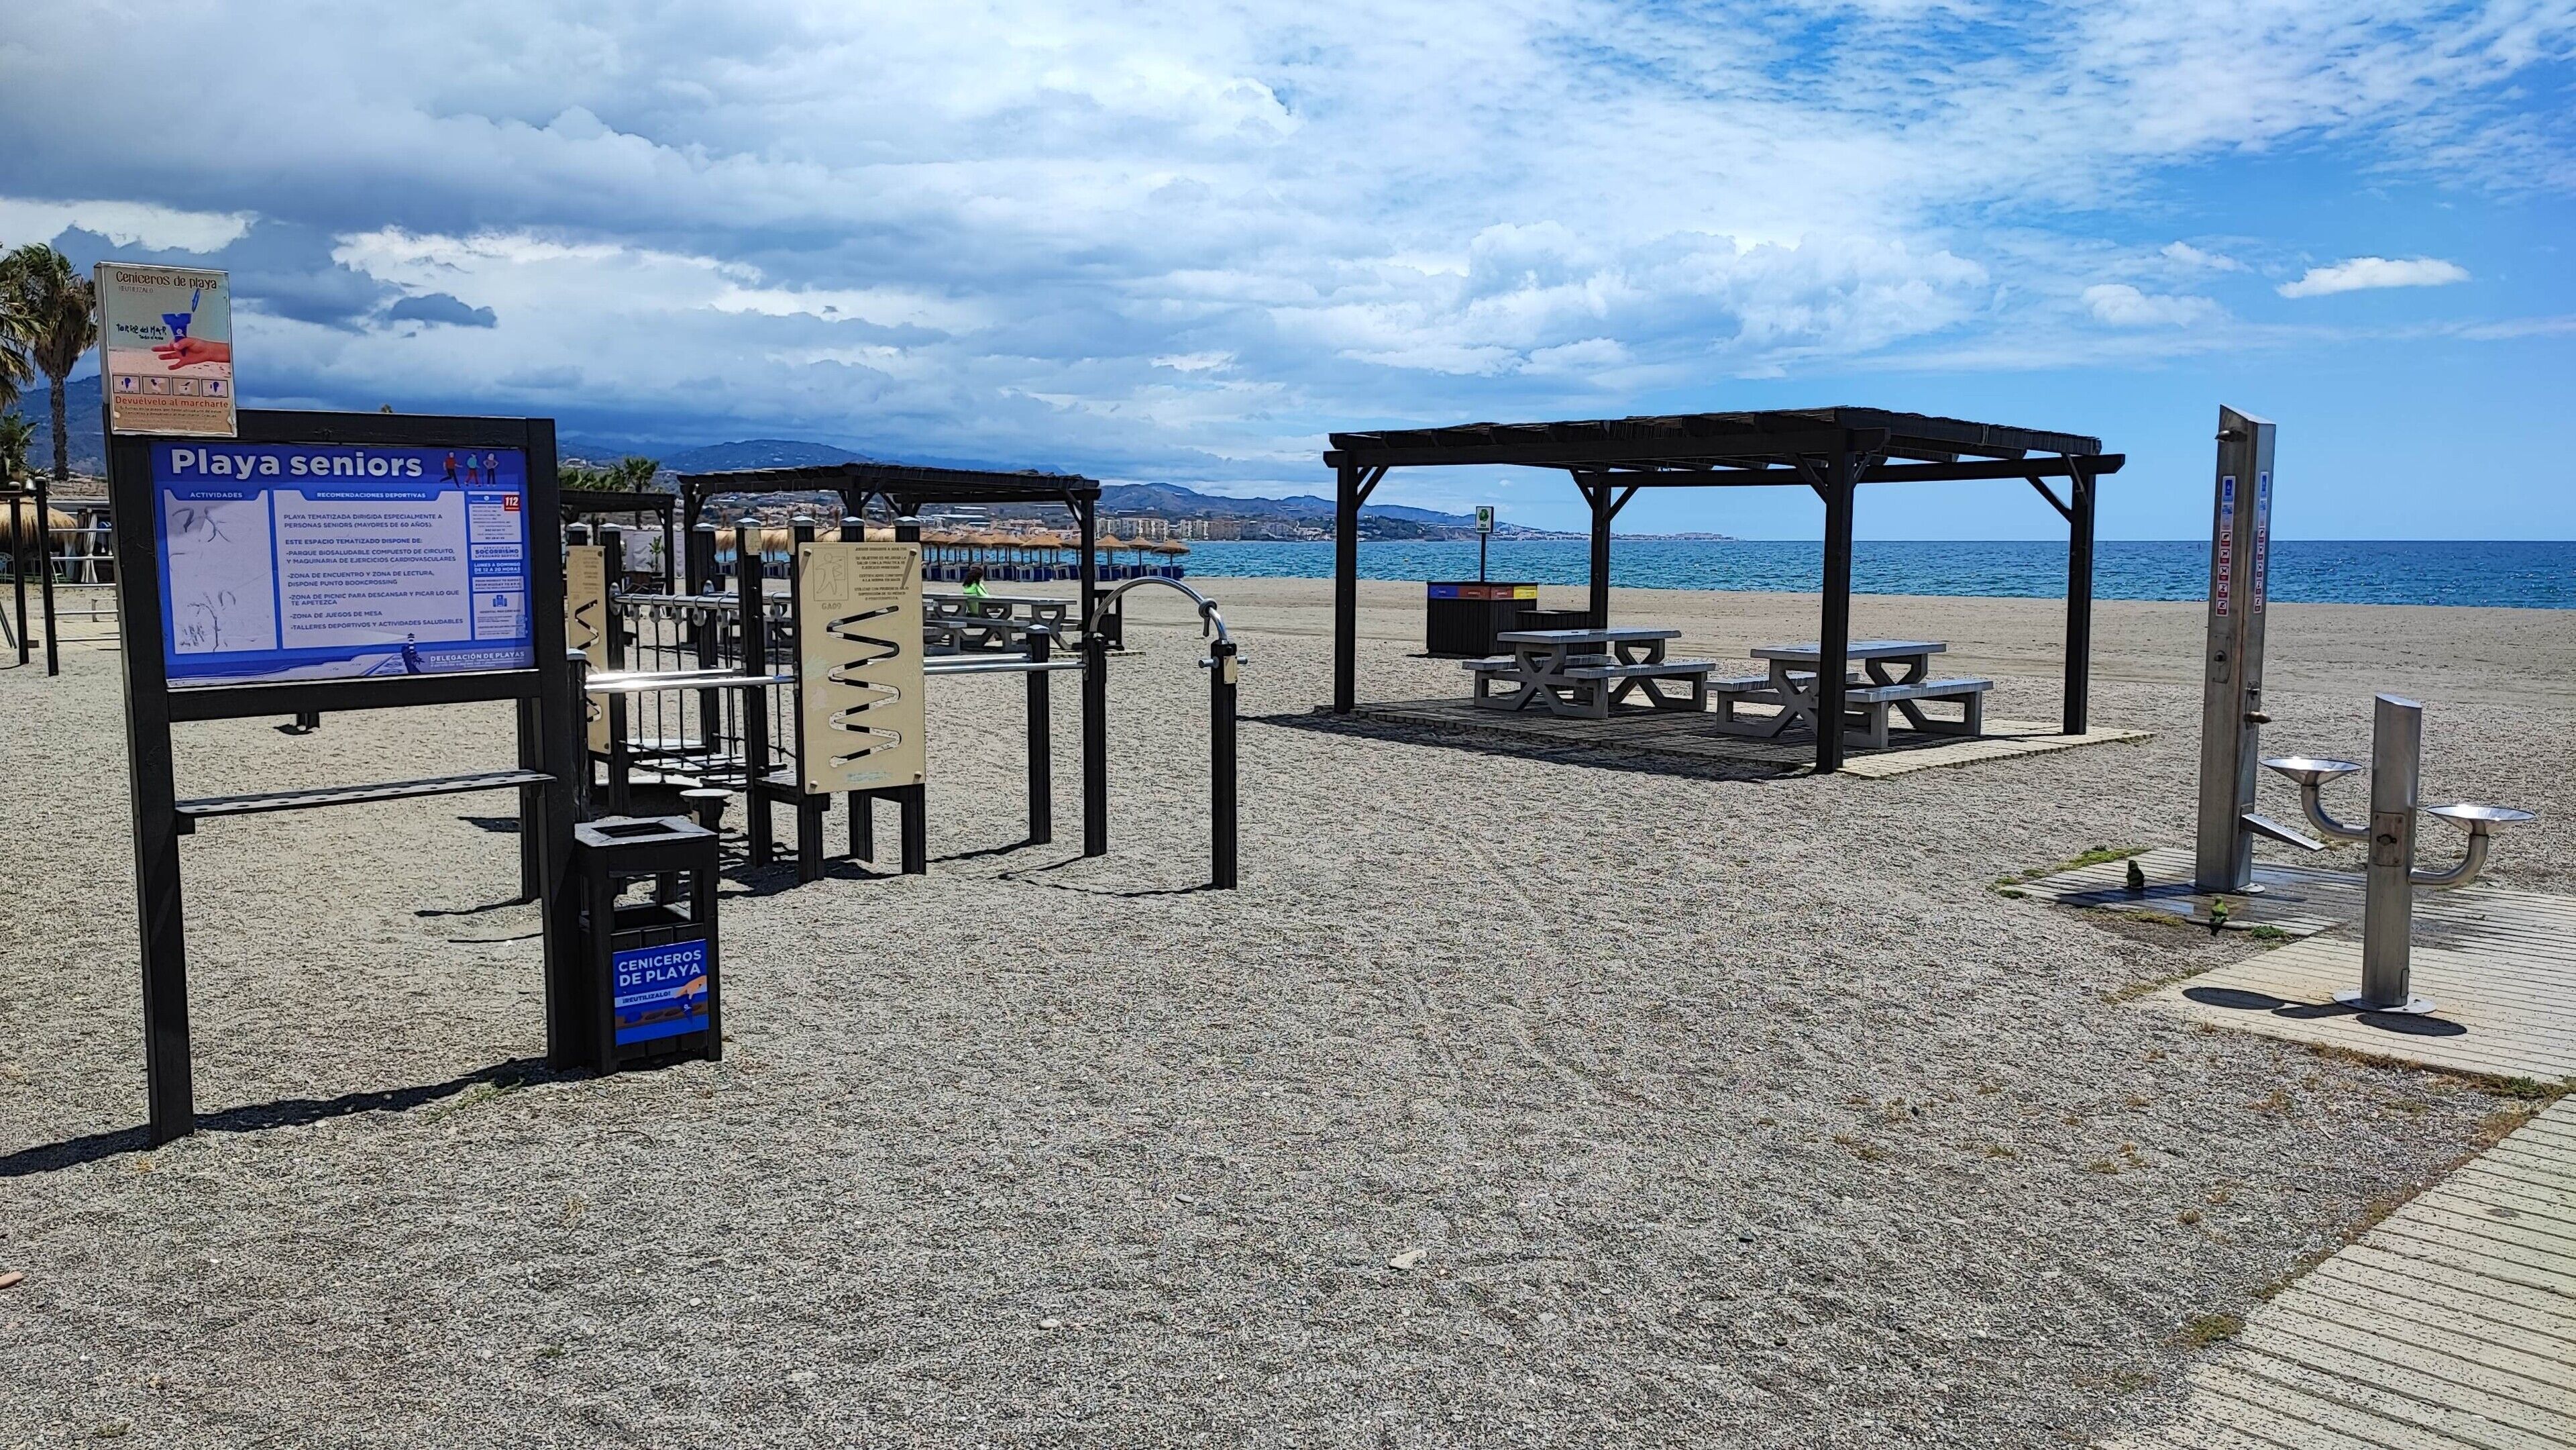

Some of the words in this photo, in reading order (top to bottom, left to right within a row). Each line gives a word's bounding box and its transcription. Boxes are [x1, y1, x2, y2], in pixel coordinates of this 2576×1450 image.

[116, 271, 170, 286] Ceniceros
[174, 275, 186, 287] de
[189, 278, 217, 290] playa
[150, 326, 166, 336] MAR
[115, 396, 166, 405] Devuélvelo
[181, 400, 228, 408] marcharte
[172, 449, 280, 480] Playa
[290, 452, 423, 477] seniors
[505, 497, 519, 506] 112
[431, 654, 482, 662] DELEGACIÓN
[619, 950, 702, 972] CENICEROS
[620, 972, 642, 987] DE
[646, 963, 701, 982] PLAYA
